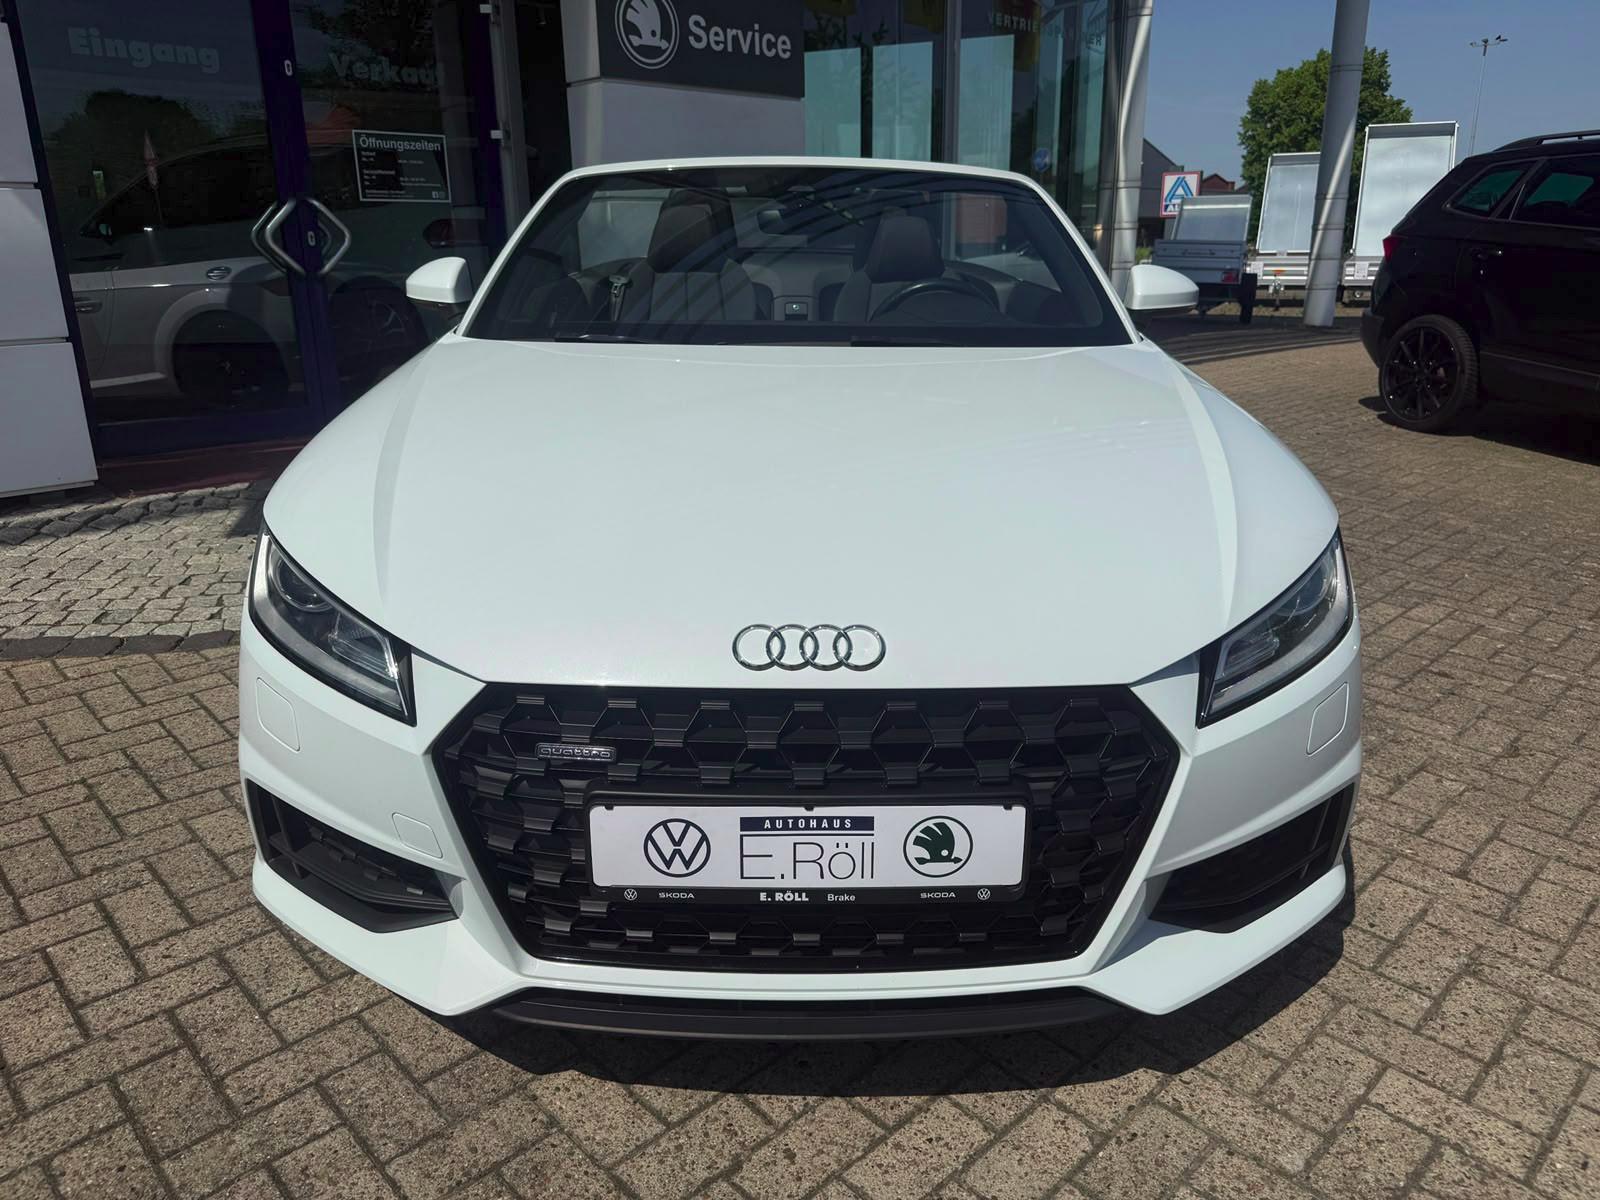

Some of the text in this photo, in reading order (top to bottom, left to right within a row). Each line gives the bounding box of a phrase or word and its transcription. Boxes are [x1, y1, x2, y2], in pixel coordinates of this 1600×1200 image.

[687, 14, 792, 59] Service
[67, 26, 221, 74] Eingang
[359, 134, 442, 152] Öffnungszeiten
[540, 745, 612, 759] quattro
[763, 818, 853, 829] AUTOHAUS
[775, 890, 809, 902] RÖLL
[827, 893, 856, 902] Brake
